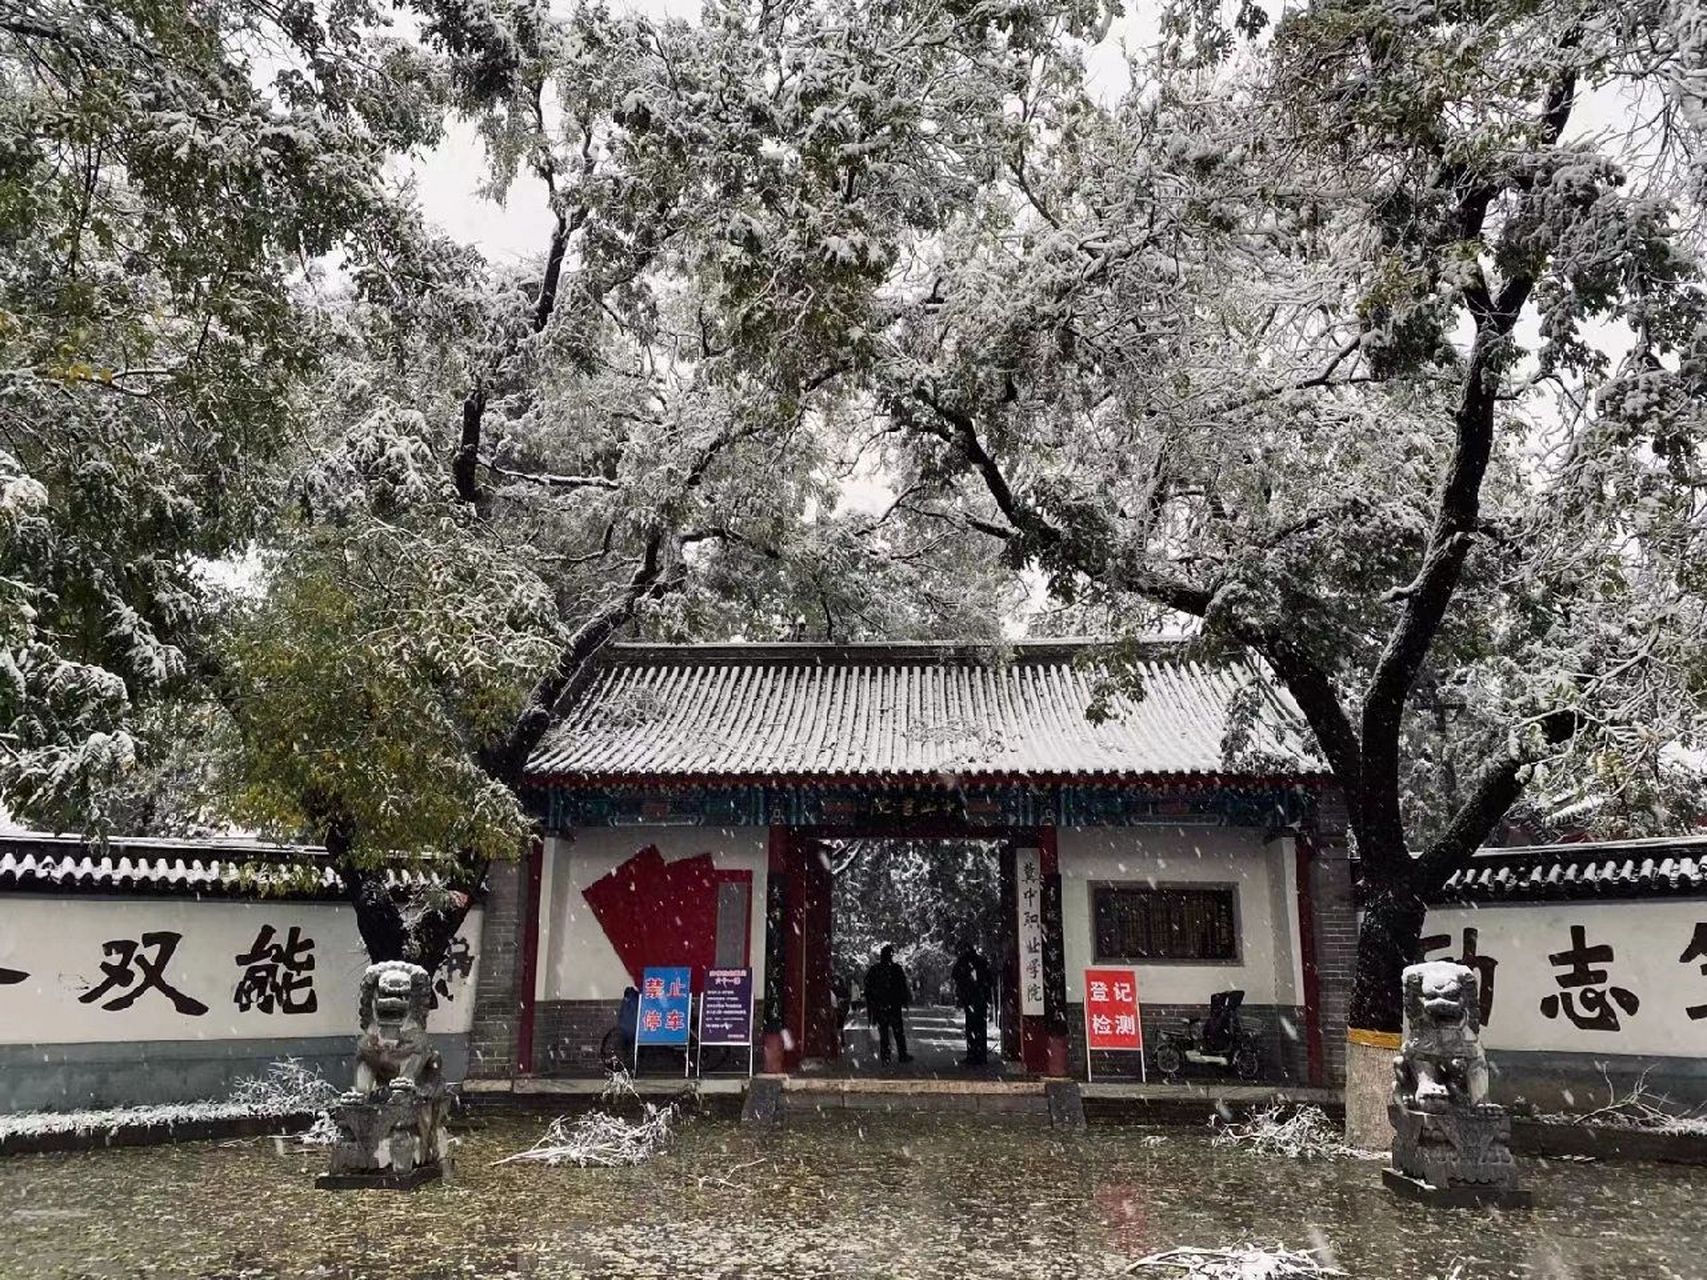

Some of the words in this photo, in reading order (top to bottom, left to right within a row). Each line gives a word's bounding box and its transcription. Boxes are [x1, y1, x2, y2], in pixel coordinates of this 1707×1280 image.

[645, 977, 687, 999] 禁止
[1090, 981, 1132, 1002] 登记
[643, 1010, 685, 1031] 停车
[1092, 1014, 1136, 1035] 检测
